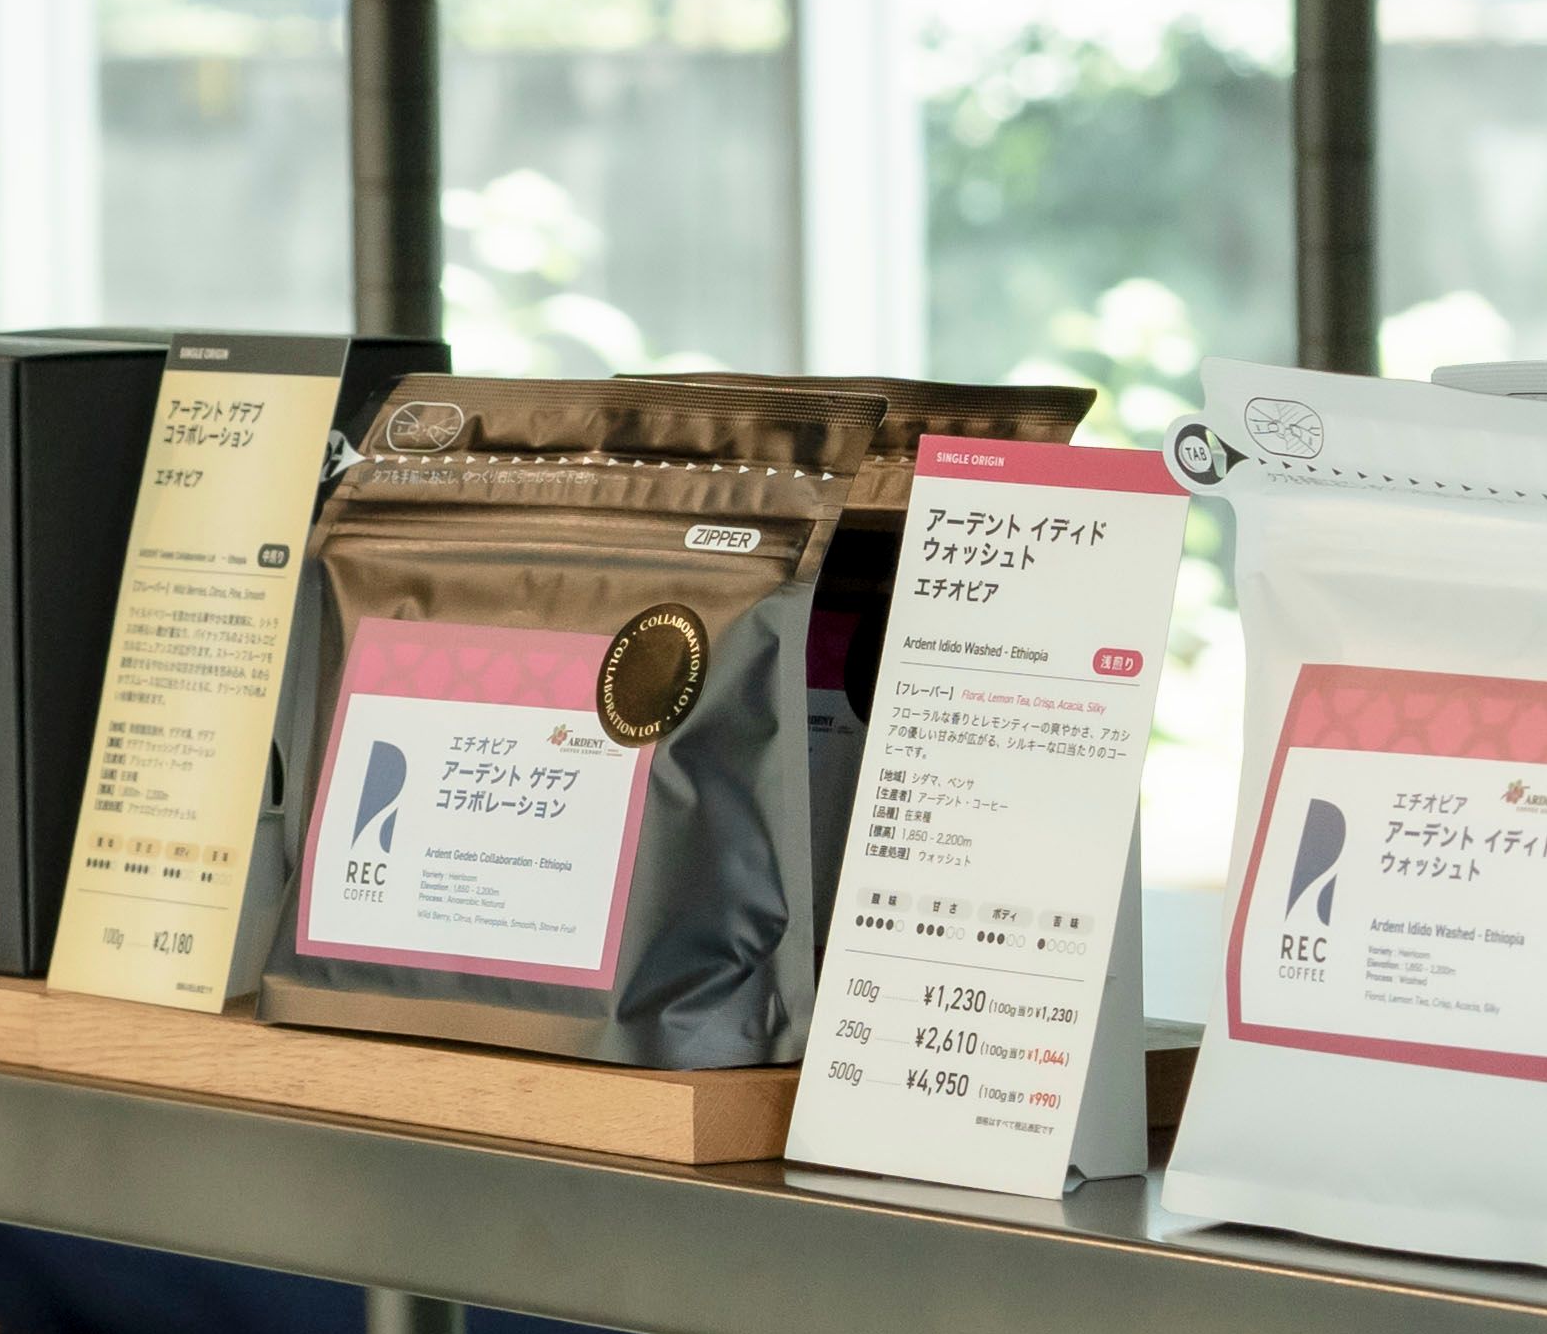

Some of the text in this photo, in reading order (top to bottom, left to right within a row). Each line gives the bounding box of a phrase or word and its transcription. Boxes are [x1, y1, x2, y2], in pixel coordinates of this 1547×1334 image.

[167, 400, 264, 423] アーデント ゲデブ
[164, 424, 254, 448] コラボレーション
[936, 451, 1005, 468] SINGLE ORIGIN
[1184, 445, 1208, 462] TAB
[155, 469, 203, 488] エチオピア
[692, 528, 752, 550] ZIPPER
[926, 507, 1107, 546] アーデント イディド
[922, 536, 1036, 571] ウォッシュト
[913, 576, 1000, 604] エチオピア
[903, 636, 1050, 663] Ardent Idido Washed Ethiopia
[1100, 653, 1135, 672] 浅煎り
[891, 705, 1132, 742] フローラルな香りとレモンティーの爽やかさ、アカシ
[450, 736, 518, 756] エチオピア
[884, 742, 928, 761] ヒーです。
[887, 724, 1127, 760] アの優しい甘みが広がる、シルキーな口当たりのコー
[441, 760, 580, 792] アーデント ゲデブ
[436, 788, 567, 819] コラボレーション
[876, 786, 1009, 812] 【生産者】 アーデント・コーヒー
[1393, 792, 1468, 815] エチオピア
[1385, 819, 1475, 851] アーデント
[425, 847, 573, 873] Ardent Gedeb Collaboration Ethiopia
[865, 841, 972, 867] 【生産処理】 ウォッシュト
[1380, 852, 1481, 882] ウォッシュト
[346, 860, 388, 887] REC
[343, 888, 385, 903] COFFEE
[1370, 918, 1526, 947] Ardent Idido Washed Ethiopia
[1280, 933, 1329, 963] REC
[1278, 965, 1326, 984] COFFEE
[845, 976, 987, 1014] 100g ¥1,230
[835, 1019, 978, 1056] 250g ¥2,610
[827, 1060, 970, 1098] 500g ¥4,950
